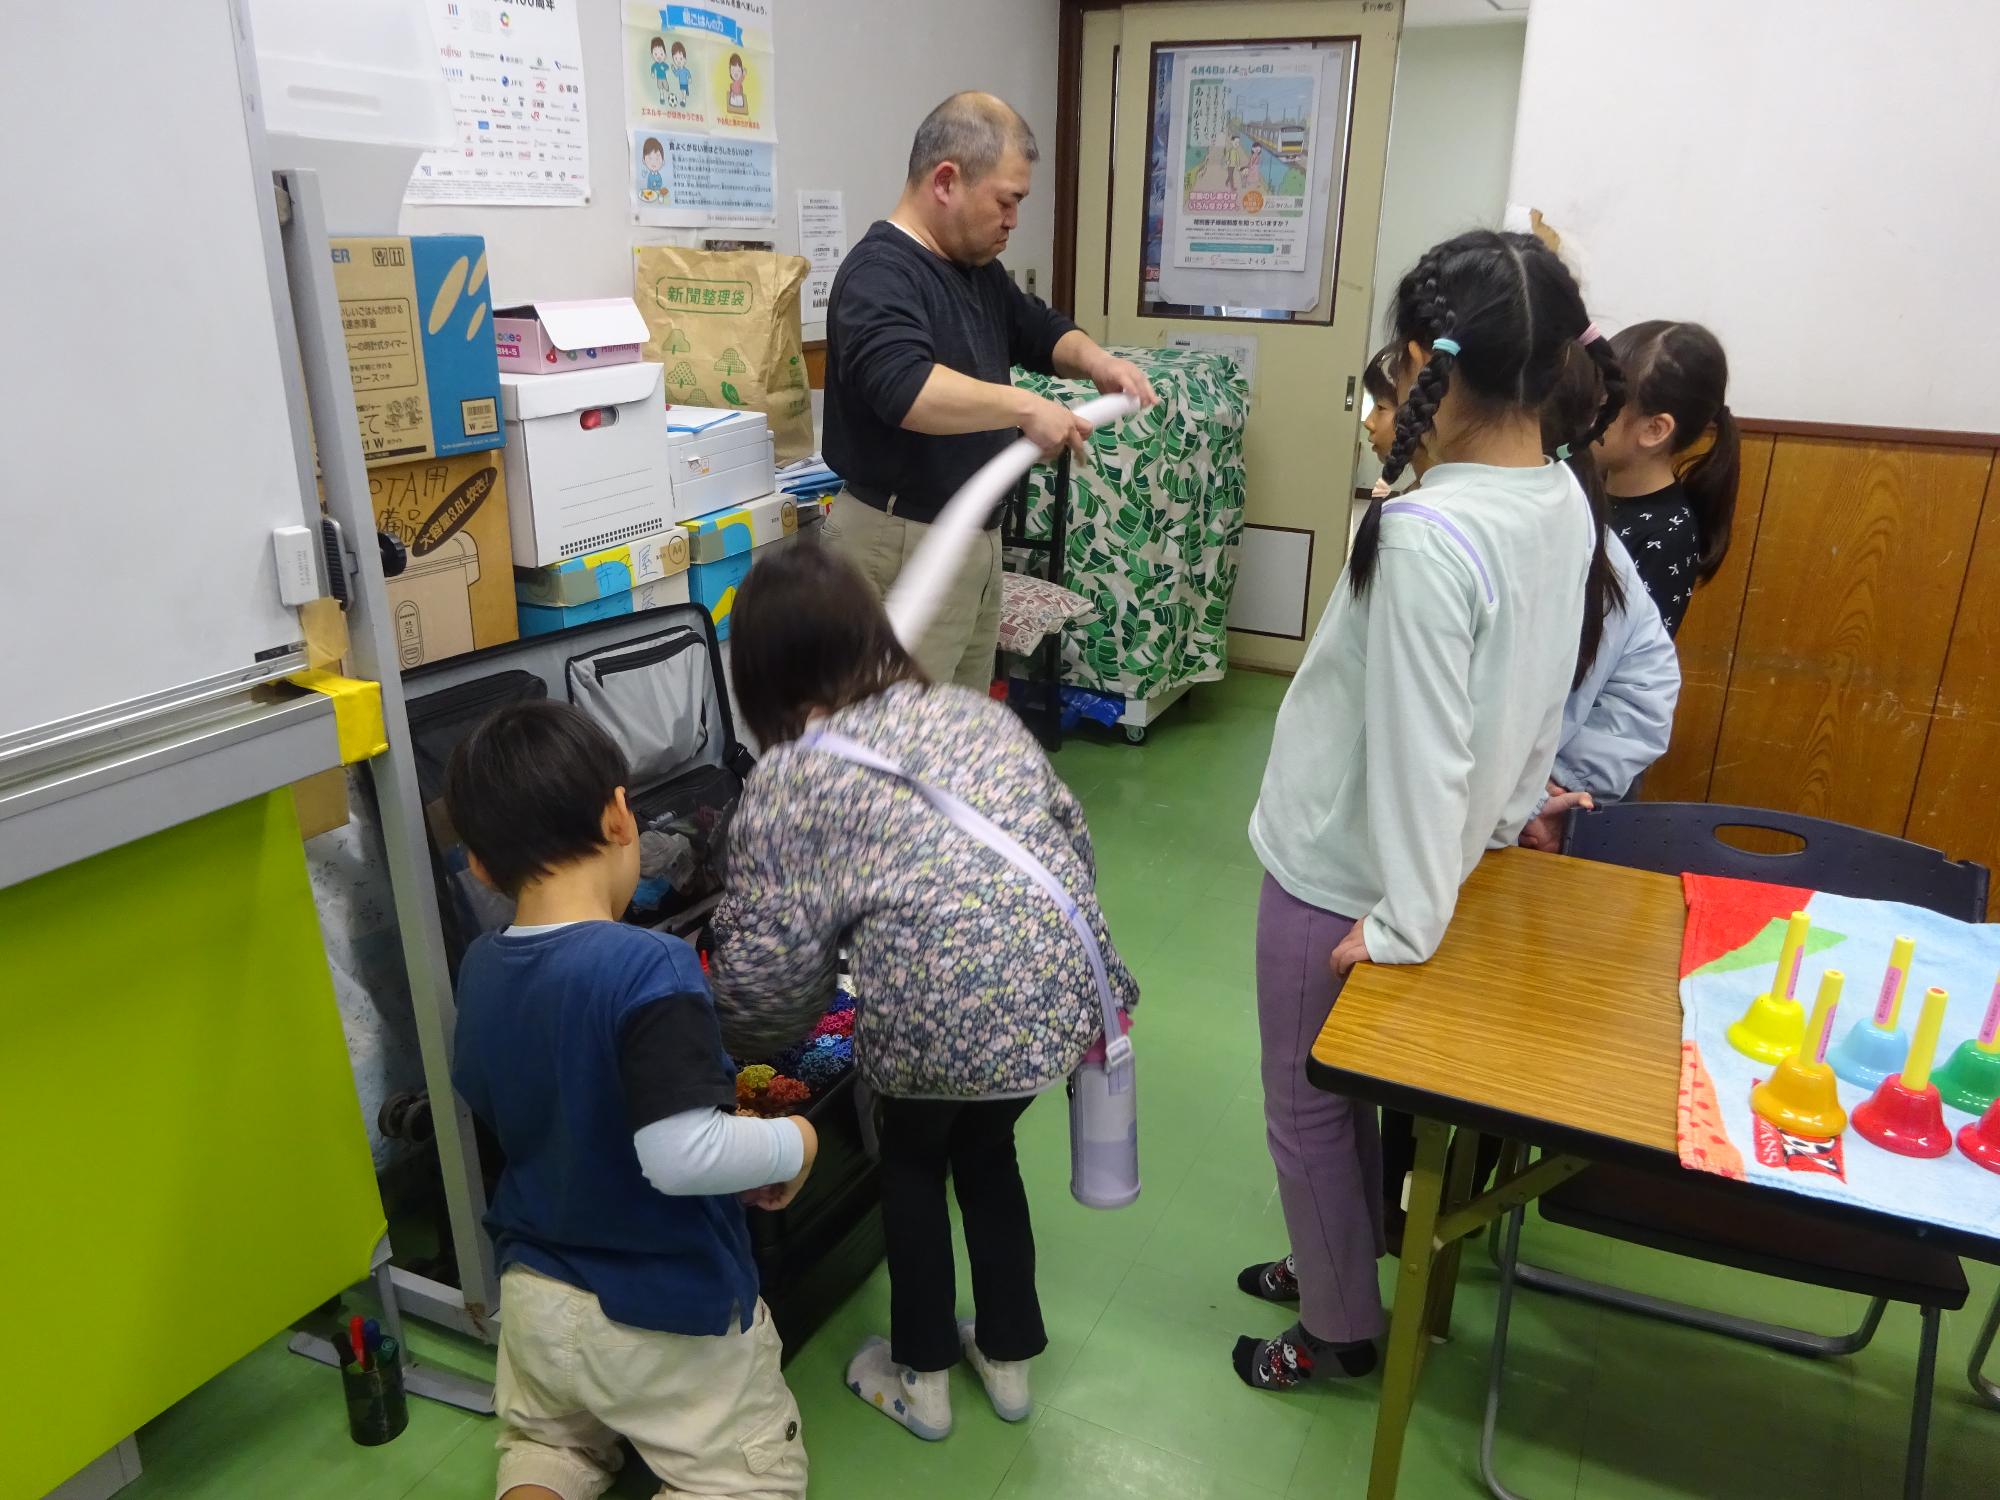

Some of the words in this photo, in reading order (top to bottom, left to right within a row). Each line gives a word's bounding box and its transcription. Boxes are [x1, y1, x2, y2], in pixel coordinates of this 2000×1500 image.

[667, 285, 745, 306] 新聞整理袋
[496, 345, 518, 356] BH-5
[351, 372, 391, 385] コースつき
[373, 437, 384, 449] W
